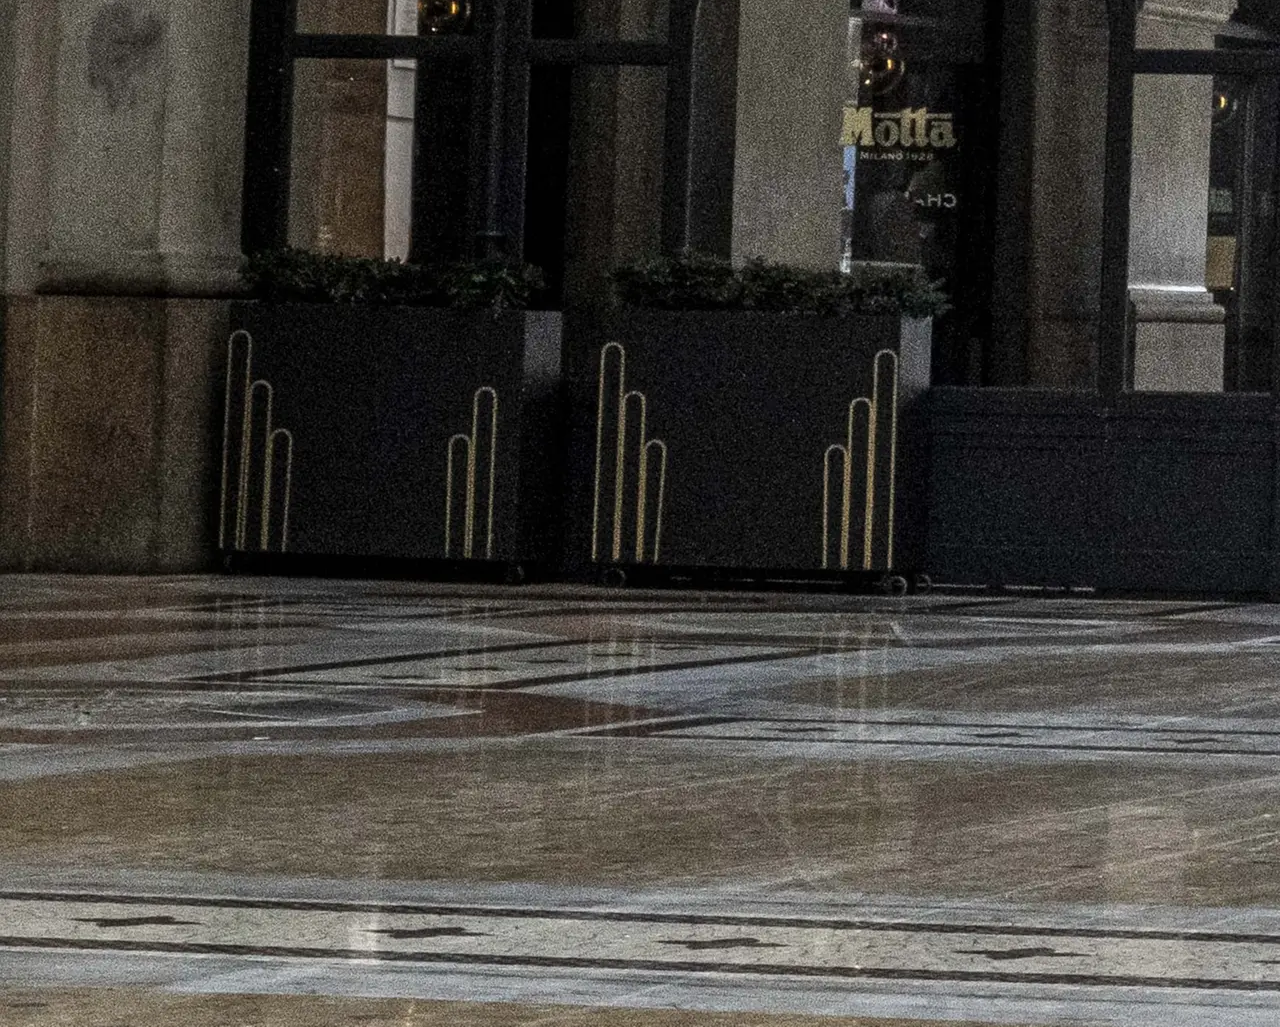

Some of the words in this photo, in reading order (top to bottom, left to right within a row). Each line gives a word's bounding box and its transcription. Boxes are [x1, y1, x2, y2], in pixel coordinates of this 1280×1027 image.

[840, 107, 957, 148] Motta
[860, 150, 904, 161] MILANO
[906, 151, 934, 161] 1928
